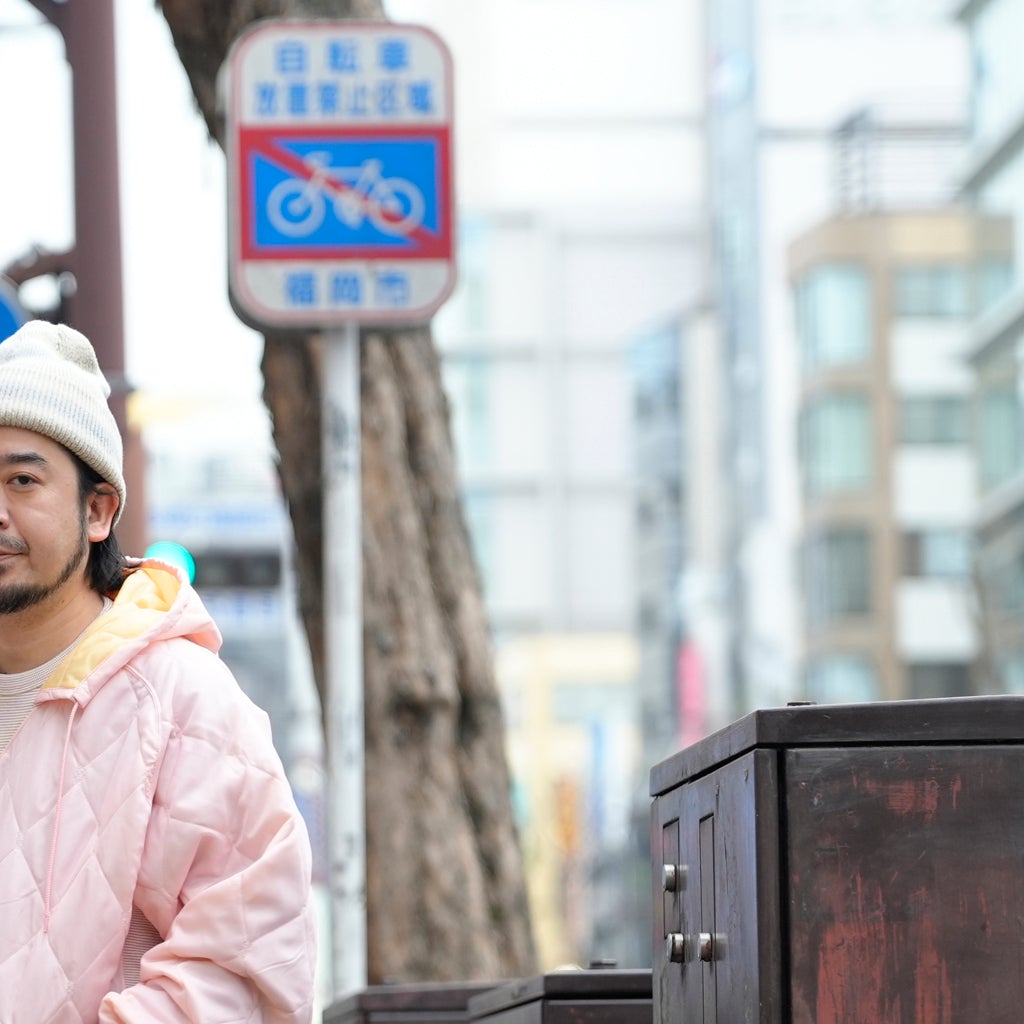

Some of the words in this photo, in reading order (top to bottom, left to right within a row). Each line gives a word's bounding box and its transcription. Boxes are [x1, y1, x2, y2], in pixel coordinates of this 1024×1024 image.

[276, 39, 409, 73] 自転車
[286, 271, 408, 306] 福岡市
